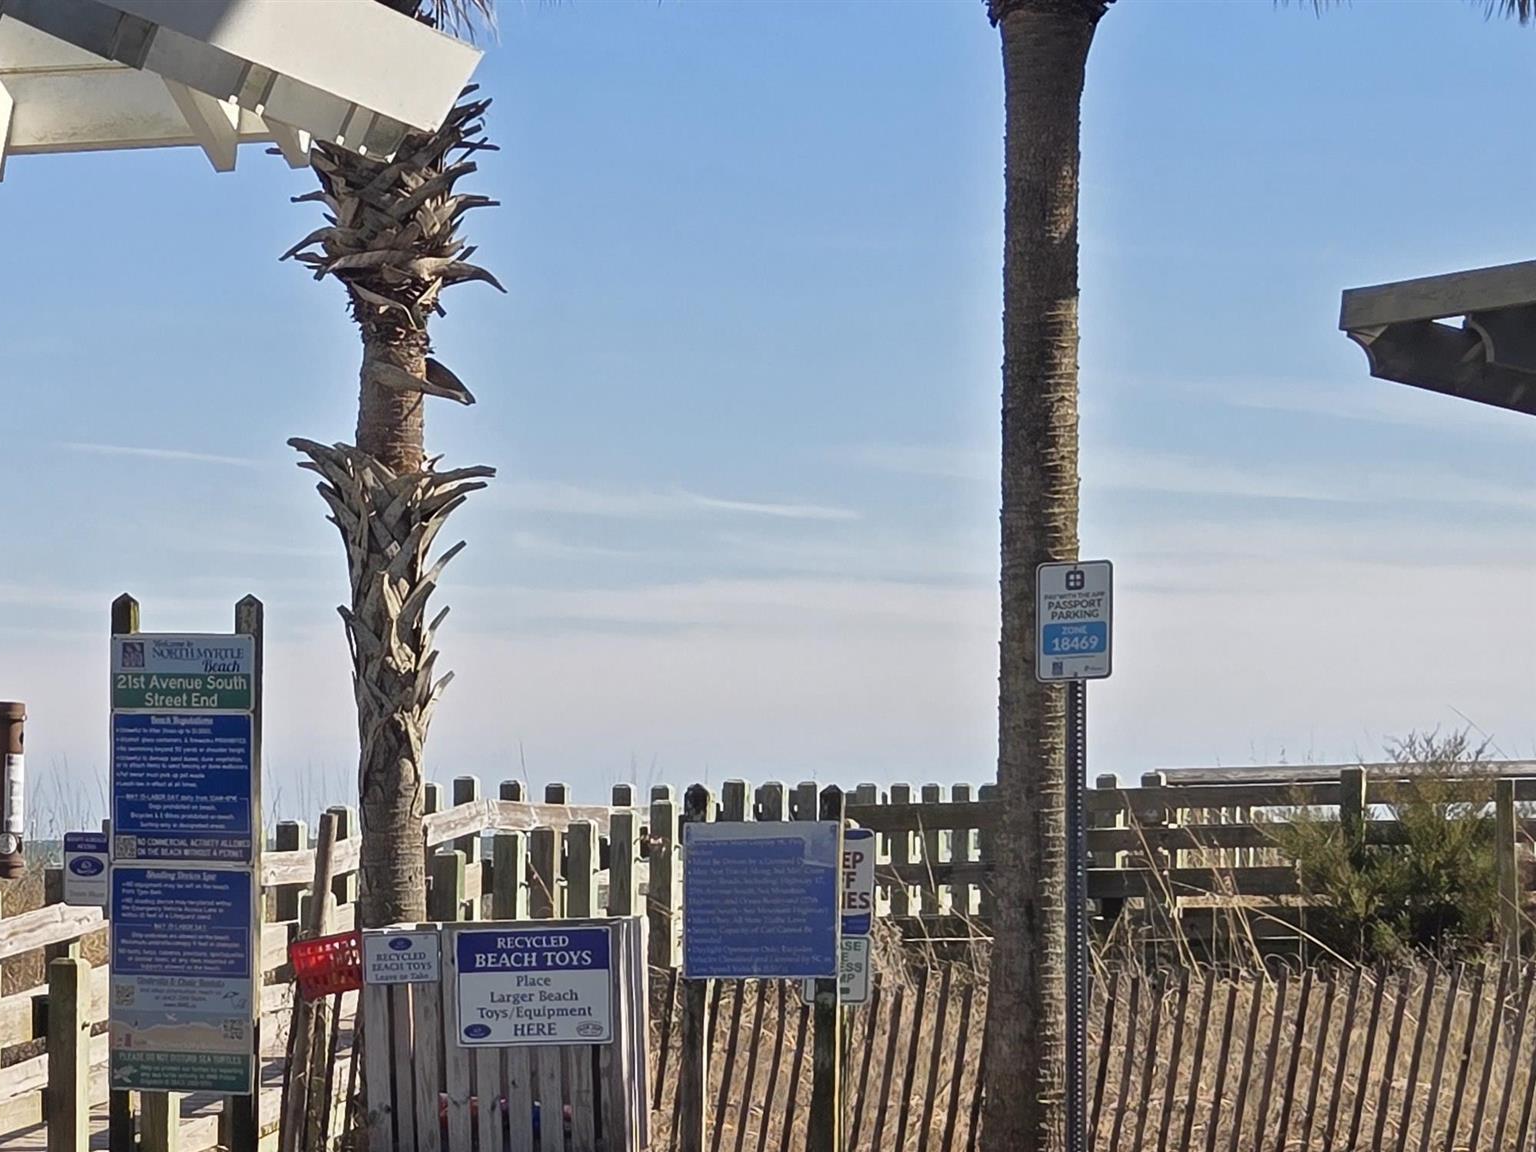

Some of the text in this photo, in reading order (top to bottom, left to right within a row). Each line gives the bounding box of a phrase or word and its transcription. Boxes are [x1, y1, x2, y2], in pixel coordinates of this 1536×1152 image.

[1048, 599, 1103, 610] PASSPORT
[1051, 609, 1099, 620] PARKING
[1061, 625, 1088, 635] ZONE
[1052, 635, 1099, 651] 18469
[152, 647, 244, 660] NORTH MYRTLE
[202, 660, 240, 672] Beach
[117, 675, 247, 690] 21st Avenue South
[145, 693, 218, 707] Street End
[497, 935, 569, 949] RECYCLED
[376, 952, 426, 961] RECYCLED
[475, 950, 592, 968] BEACH TOYS
[372, 962, 432, 971] BEACH TOYS
[516, 975, 551, 987] Place
[490, 989, 579, 1005] Larger Beach
[477, 1006, 593, 1021] Toys/Equipment
[514, 1022, 557, 1036] HERE
